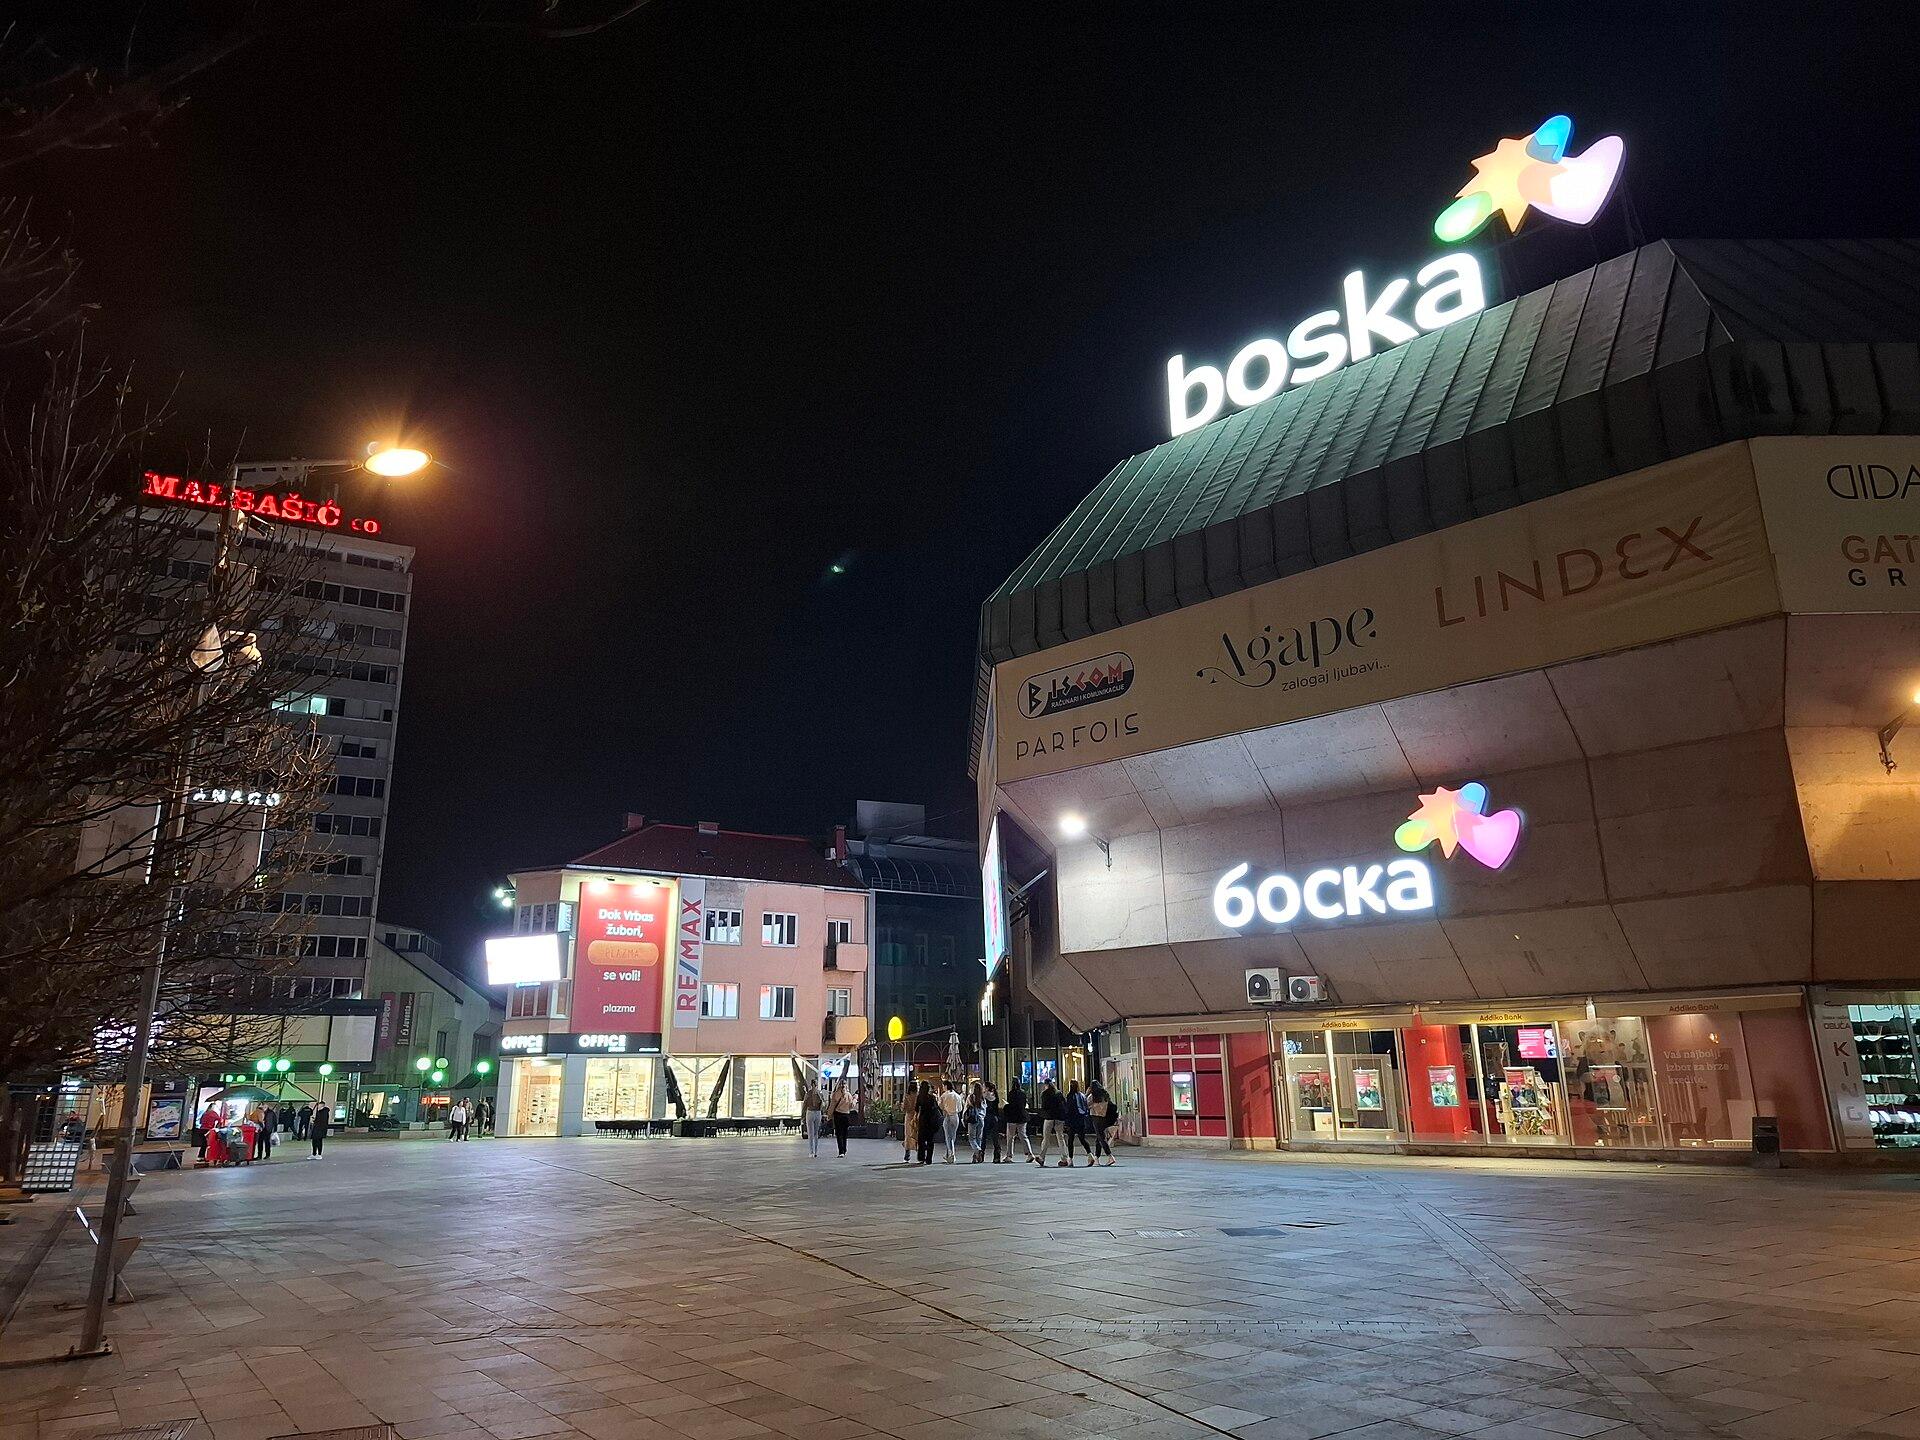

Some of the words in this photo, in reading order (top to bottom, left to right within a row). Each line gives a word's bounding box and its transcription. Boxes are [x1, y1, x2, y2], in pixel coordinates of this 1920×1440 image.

[1167, 252, 1485, 437] boska
[1435, 516, 1713, 627] LINDEX
[1197, 608, 1376, 687] Agape
[1282, 668, 1329, 691] zalogaj
[1016, 713, 1139, 760] PARFOIS
[1213, 860, 1434, 928] боска
[599, 909, 621, 920] Dok
[624, 910, 654, 922] Vrbas
[677, 898, 702, 1011] RE/MAX
[603, 971, 616, 980] se
[619, 970, 641, 981] voli!
[603, 1004, 636, 1013] plazma
[1669, 1004, 1698, 1012] Addiko
[1699, 1003, 1719, 1011] Bank
[502, 1034, 543, 1049] OFFICE
[578, 1034, 626, 1048] OFFICE
